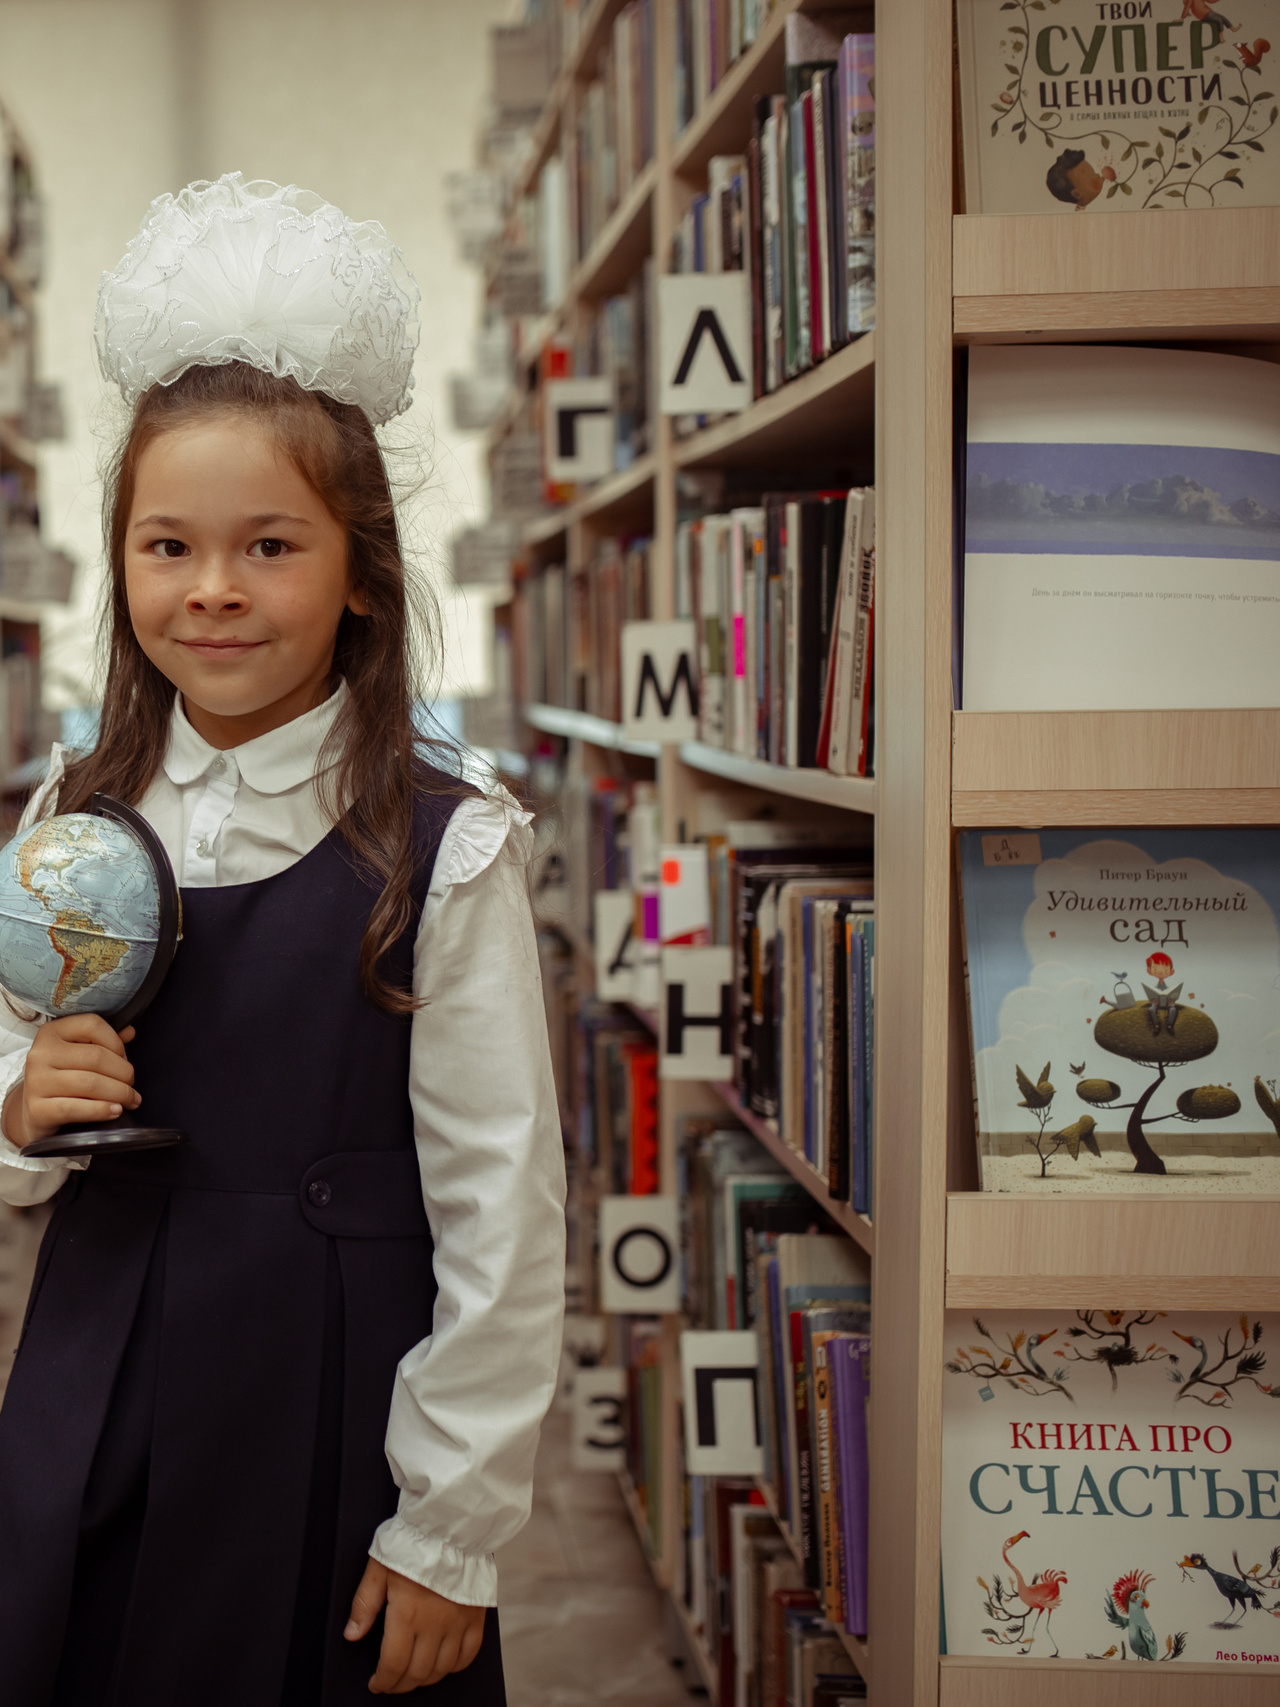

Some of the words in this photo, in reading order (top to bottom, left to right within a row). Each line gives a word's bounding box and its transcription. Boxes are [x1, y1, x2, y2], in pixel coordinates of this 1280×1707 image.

[1096, 1, 1153, 20] ТВОИ
[1035, 20, 1221, 76] СУПЕР
[1039, 73, 1223, 110] ЦЕННОСТИ
[673, 309, 745, 386] Л
[635, 653, 699, 718] М
[1099, 868, 1142, 883] Питер
[1145, 868, 1188, 883] Браун
[1047, 889, 1248, 912] Удивительный
[1109, 917, 1189, 948] сад
[666, 983, 733, 1055] Н
[613, 1227, 672, 1288] О
[694, 1367, 761, 1447] П
[1009, 1421, 1140, 1452] КНИГА
[1148, 1424, 1233, 1454] ПРО
[970, 1462, 1280, 1520] СЧАСТЬЕ
[1216, 1651, 1238, 1661] Лео
[1241, 1651, 1279, 1665] Борма
